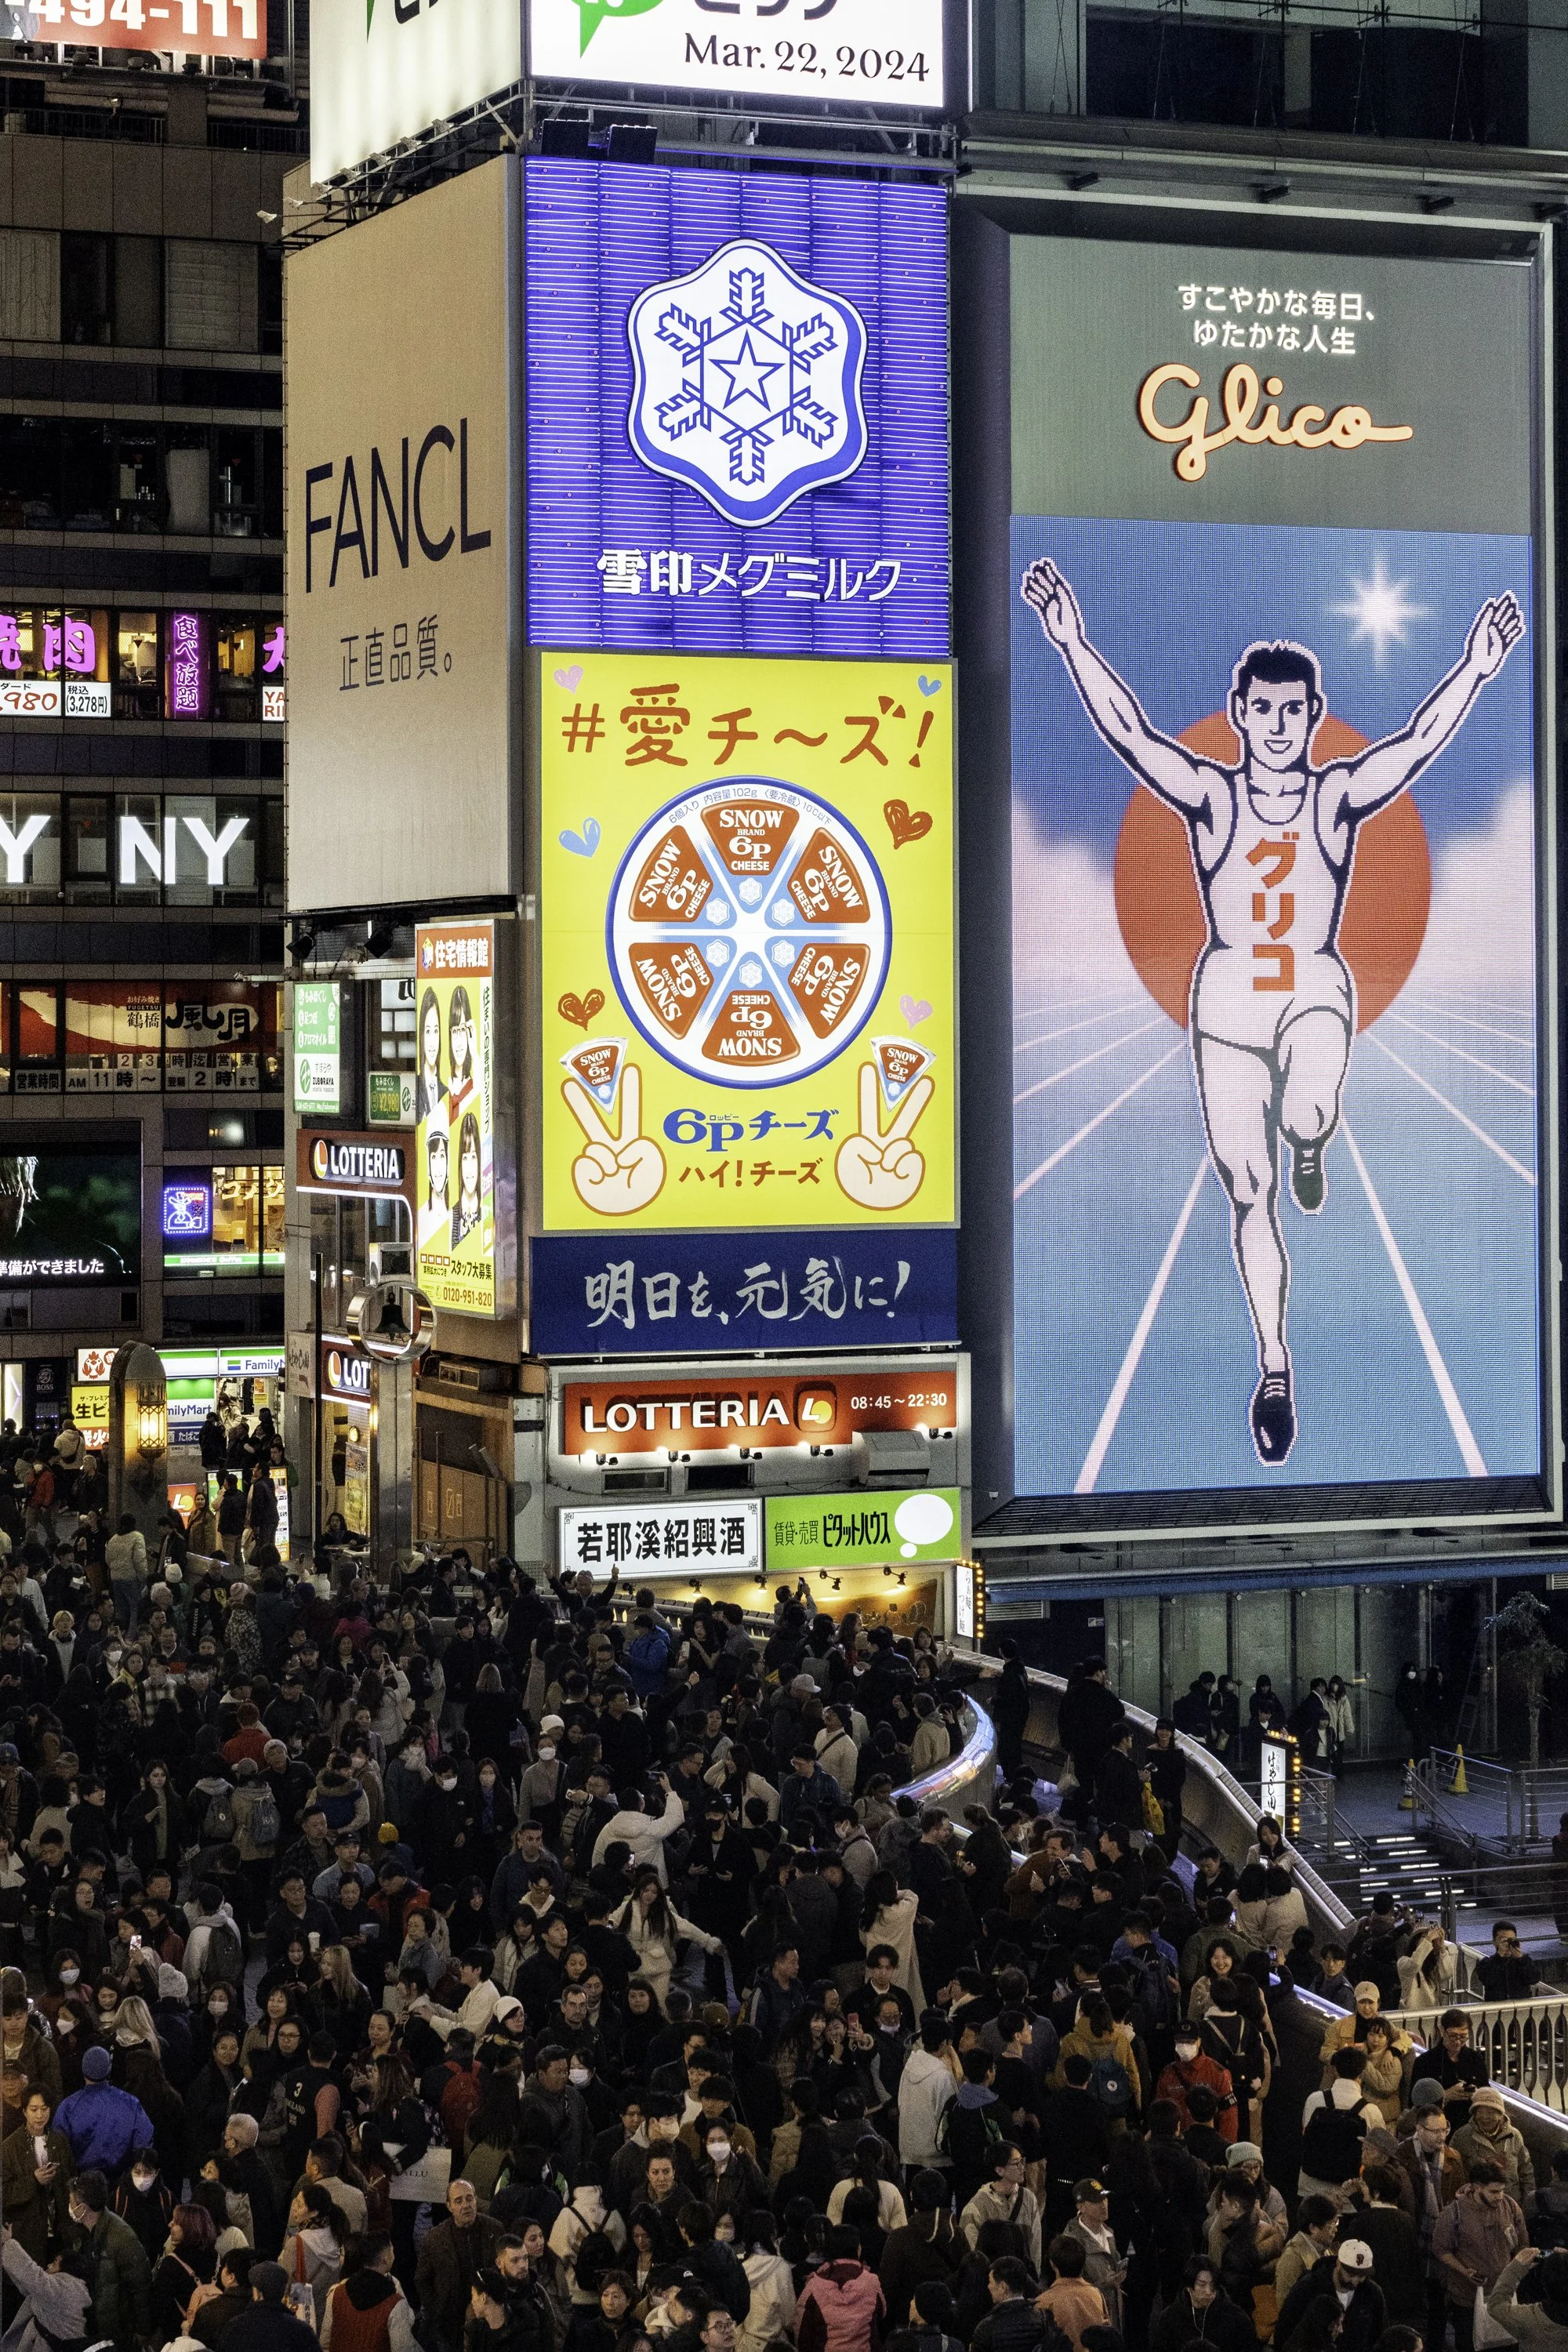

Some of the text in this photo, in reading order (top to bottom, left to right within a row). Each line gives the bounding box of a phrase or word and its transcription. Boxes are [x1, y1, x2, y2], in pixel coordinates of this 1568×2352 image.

[684, 32, 930, 82] Mar. 22, 2024
[1178, 283, 1375, 322] すこやかな毎日、
[1194, 320, 1356, 355] ゆたかな人生
[1138, 364, 1414, 482] Glico
[306, 417, 492, 593] FANCL
[597, 548, 902, 601] 雪印メグミルク
[175, 615, 198, 711] 食べ放題
[339, 614, 452, 691] 正直品質。
[66, 695, 108, 714] (3,278円)
[67, 685, 89, 695] 税込
[719, 809, 784, 828] SNOW
[121, 816, 250, 885] NY
[731, 860, 770, 871] CHEESE
[639, 839, 682, 908] SNOW
[662, 866, 681, 897] BRAND
[818, 845, 863, 909] SNOW
[821, 870, 840, 898] BRAND
[684, 878, 710, 918] CHEESE
[790, 880, 816, 920] CHEESE
[1246, 831, 1300, 992] グリコ
[435, 938, 488, 969] 住宅情報館
[684, 946, 710, 986] CHEESE
[791, 947, 816, 987] CHEESE
[636, 957, 682, 1022] SNOW
[662, 968, 679, 996] BRAND
[731, 994, 771, 1005] CHEESE
[820, 957, 861, 1025] SNOW
[821, 969, 840, 998] BRAND
[127, 1011, 160, 1029] 鶴橋
[579, 1047, 612, 1066] SNOW
[717, 1037, 782, 1057] SNOW
[887, 1047, 918, 1064] SNOW
[330, 1145, 400, 1180] LOTTERIA
[75, 1402, 110, 1419] 生ビ
[584, 1398, 790, 1434] LOTTERIA
[822, 1511, 891, 1548] ピタットハウス
